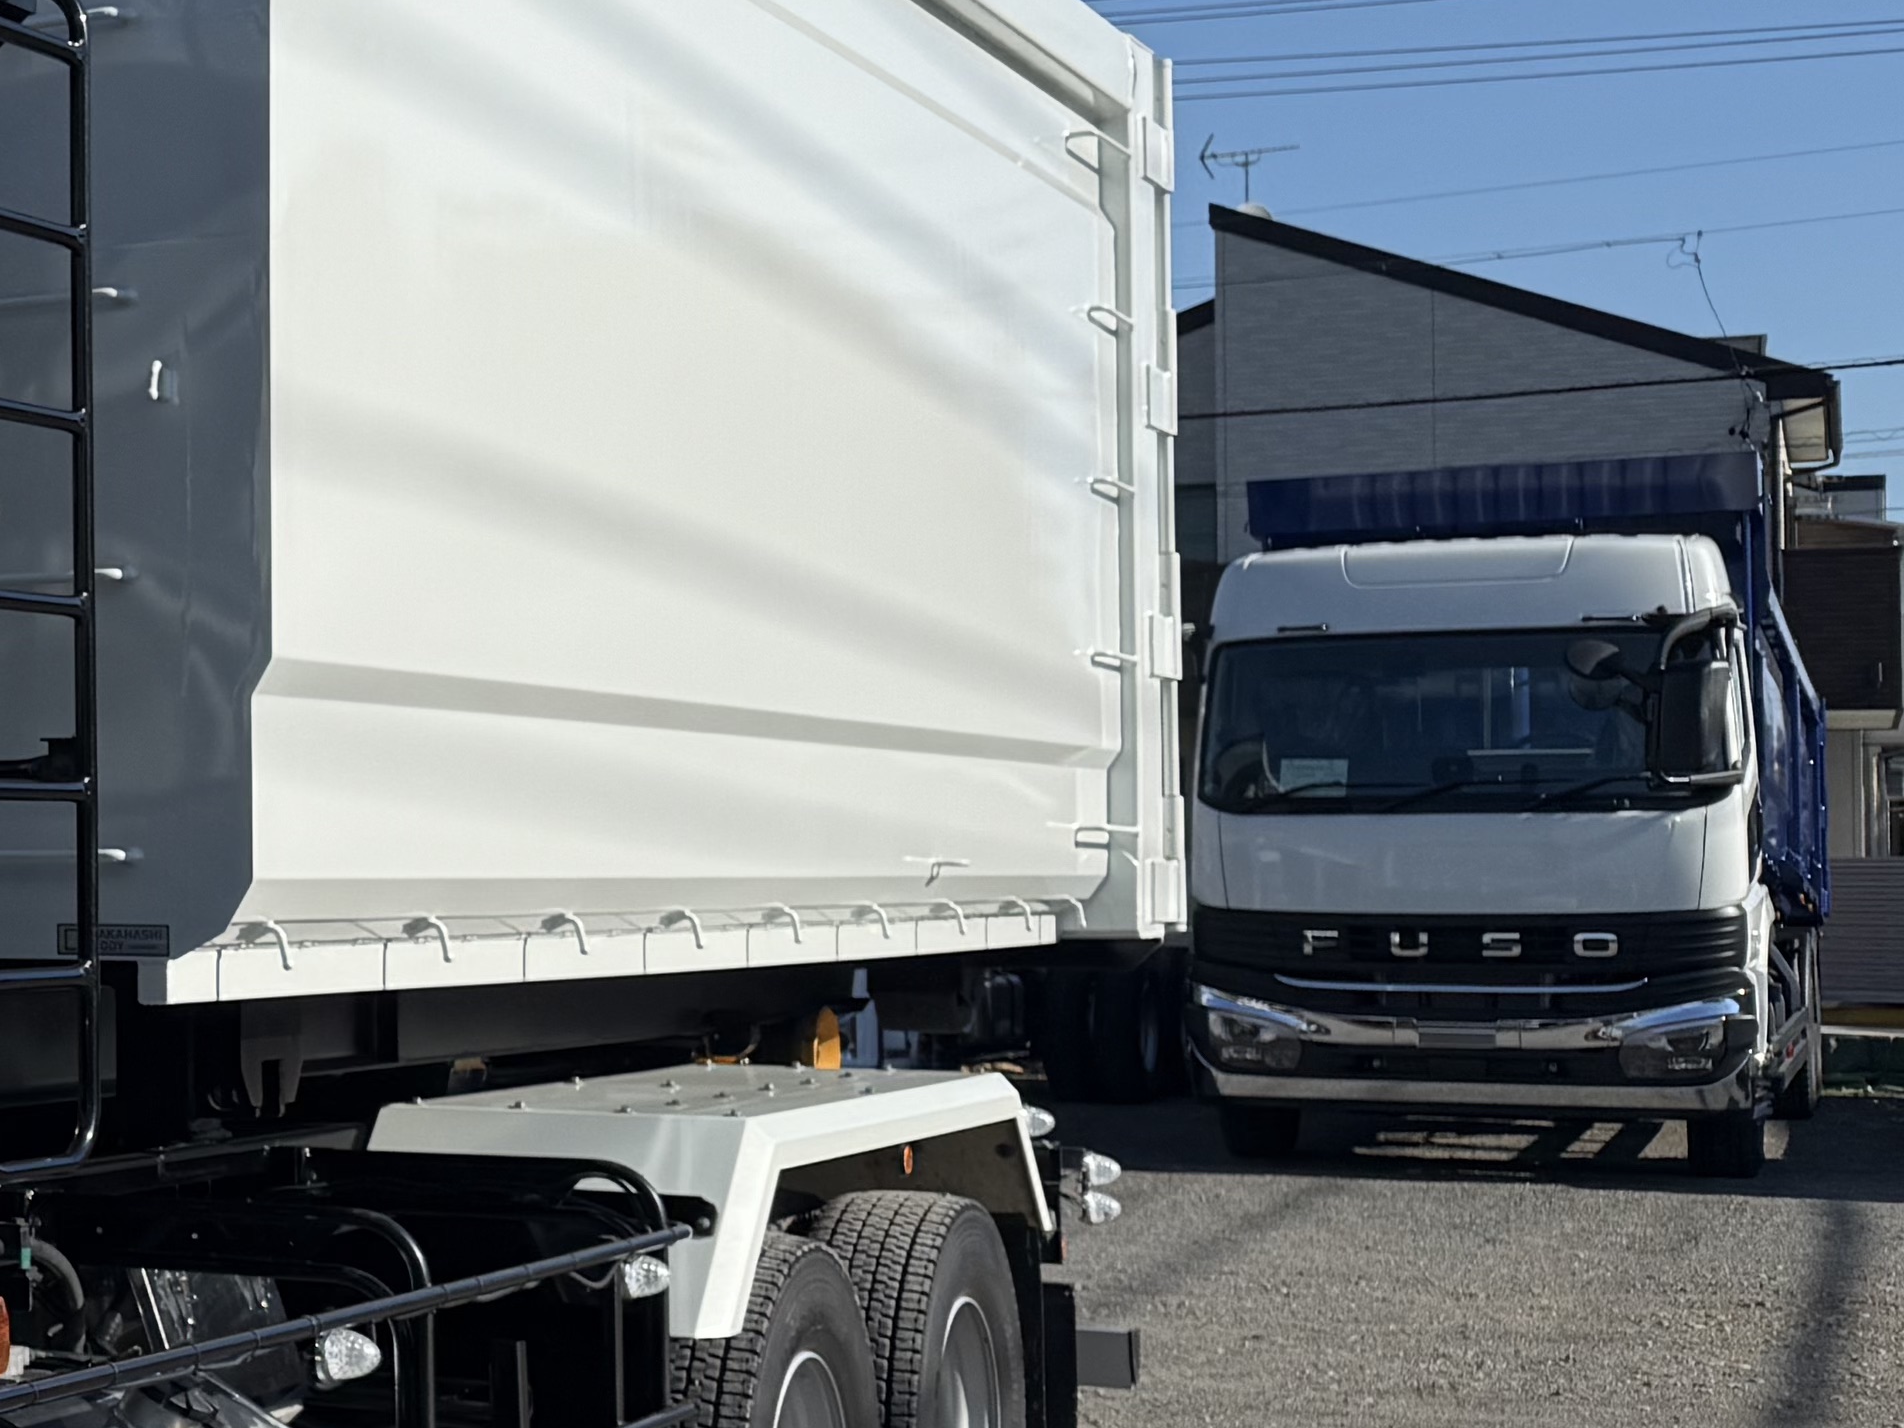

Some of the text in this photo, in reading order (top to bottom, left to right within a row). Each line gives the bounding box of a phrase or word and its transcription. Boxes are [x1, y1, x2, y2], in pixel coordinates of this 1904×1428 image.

[98, 927, 163, 940] AKAHASHI
[99, 940, 124, 951] ODY
[1302, 930, 1619, 958] FUSO
